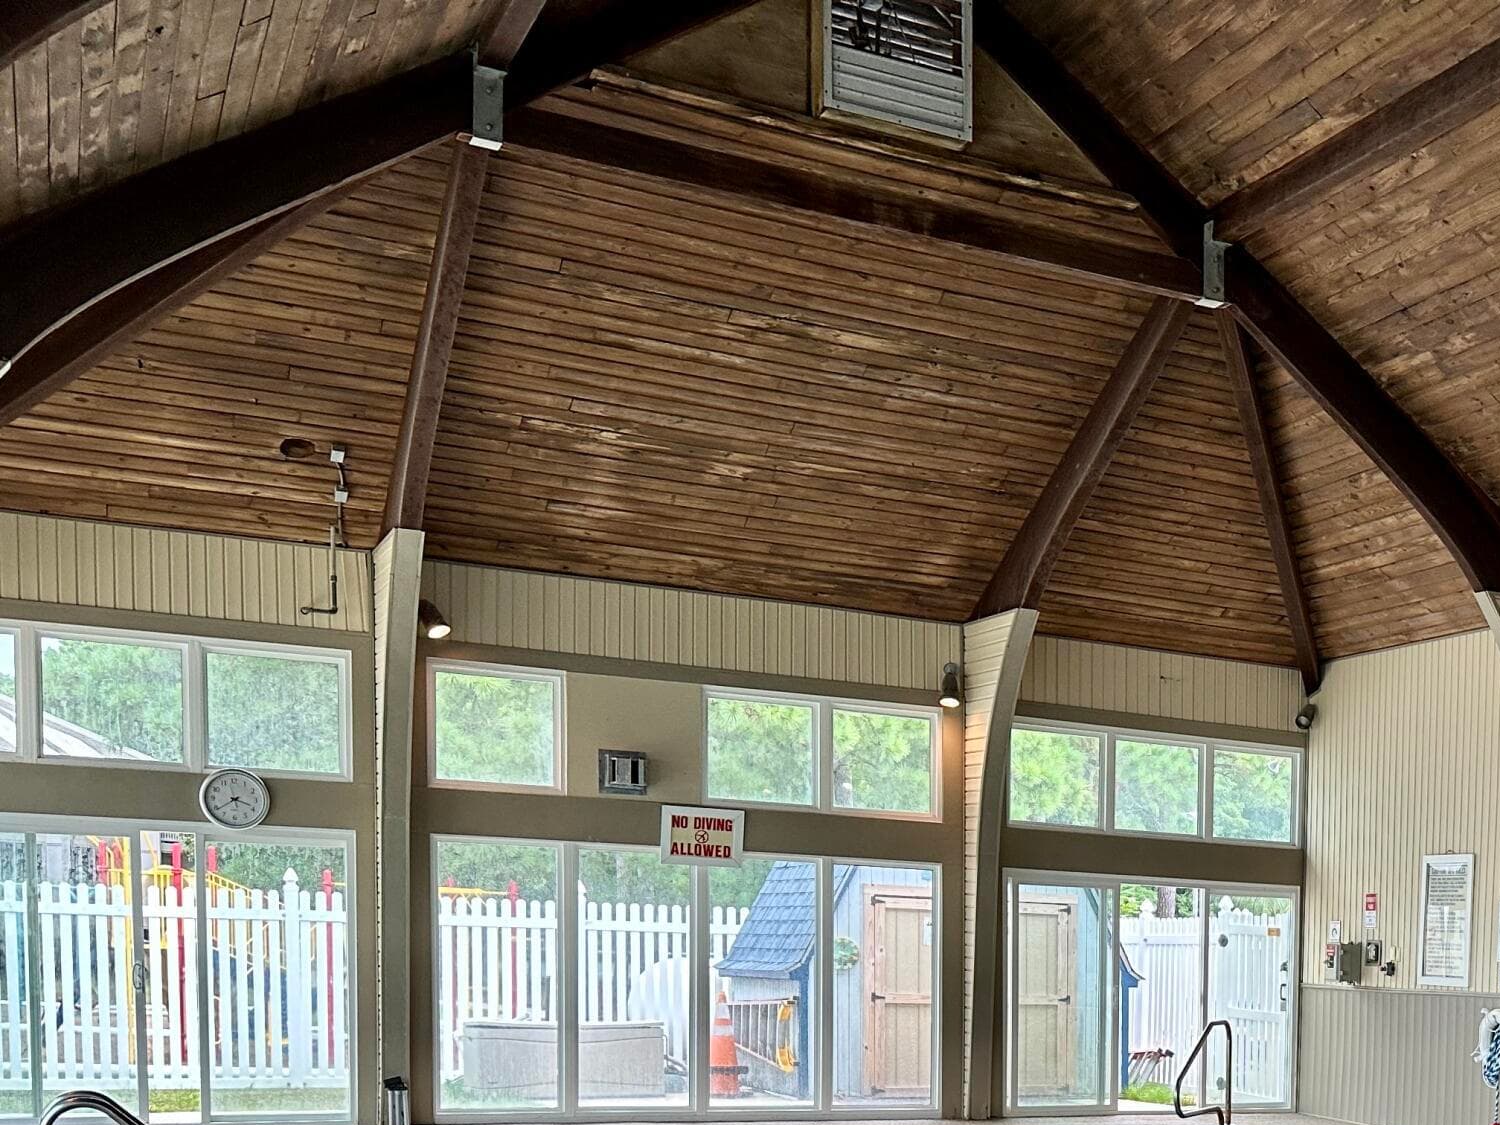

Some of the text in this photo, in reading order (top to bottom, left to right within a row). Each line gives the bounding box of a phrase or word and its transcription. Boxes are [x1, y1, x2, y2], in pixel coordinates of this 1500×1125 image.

[672, 815, 733, 832] NO DIVING
[671, 842, 731, 858] ALLOWED
